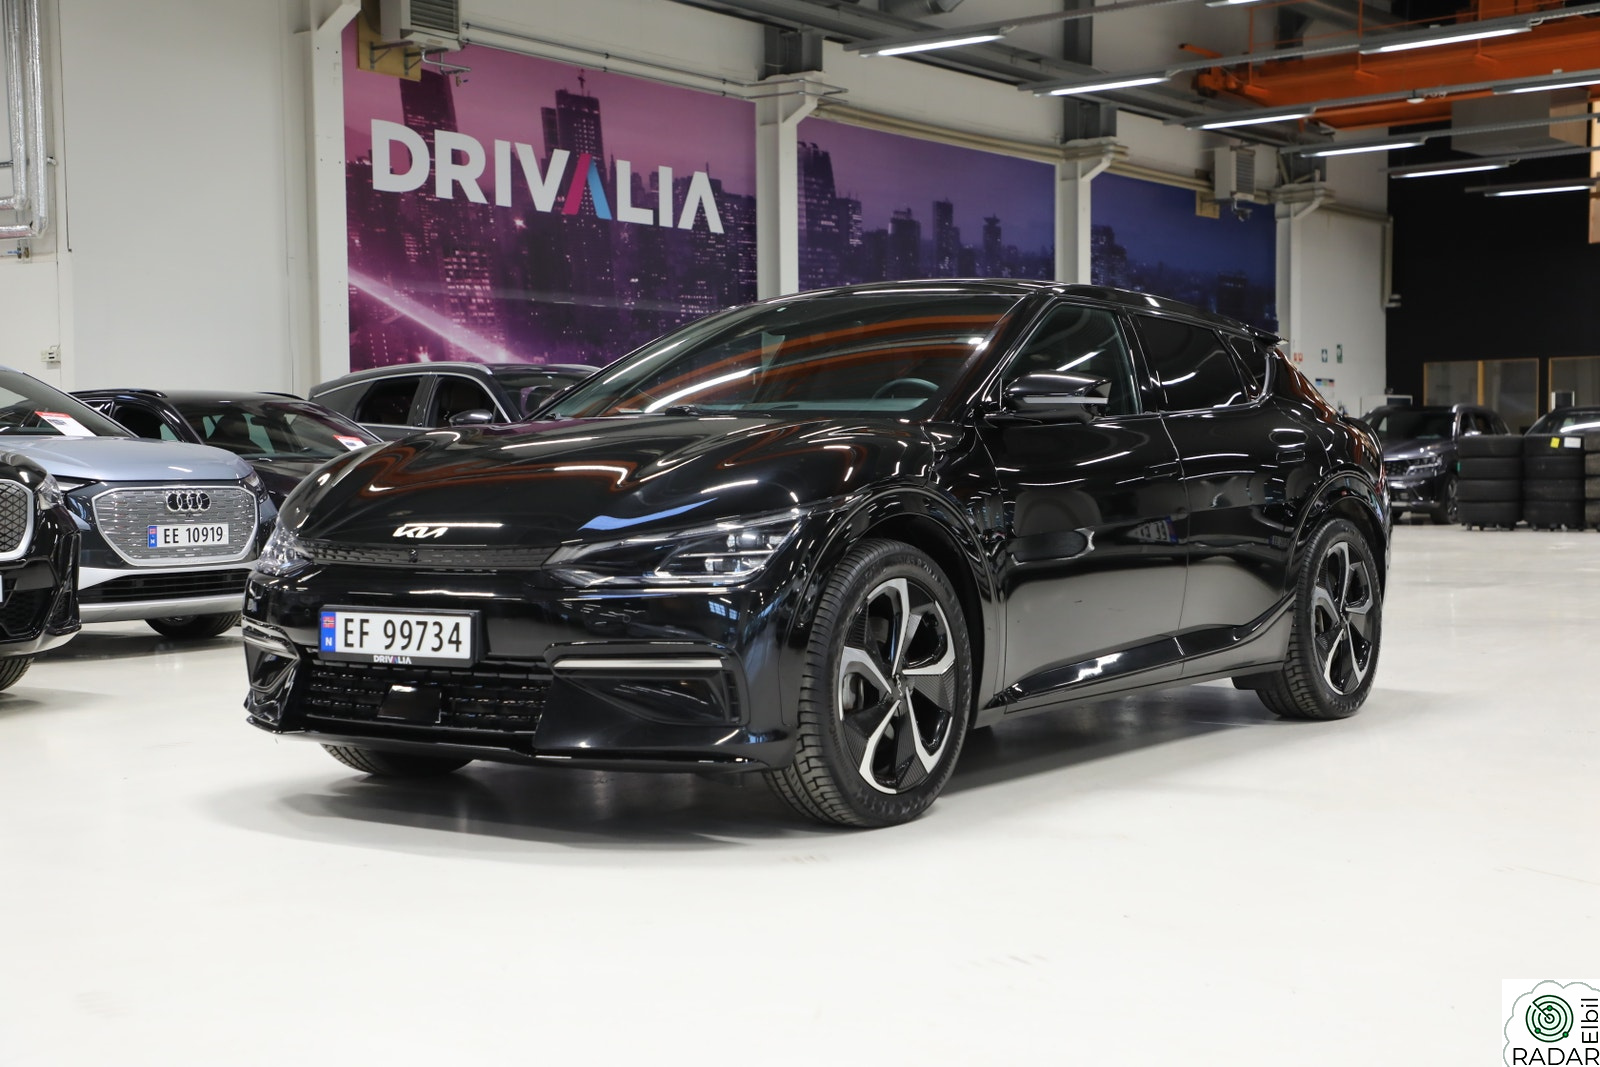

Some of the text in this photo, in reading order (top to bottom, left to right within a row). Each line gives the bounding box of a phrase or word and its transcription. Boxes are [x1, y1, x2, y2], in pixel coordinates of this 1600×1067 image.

[371, 119, 724, 234] DRIVALIA
[164, 528, 179, 544] EE
[186, 526, 223, 543] 10919
[325, 617, 462, 653] N EF 99734
[373, 655, 412, 665] DRIVALIA
